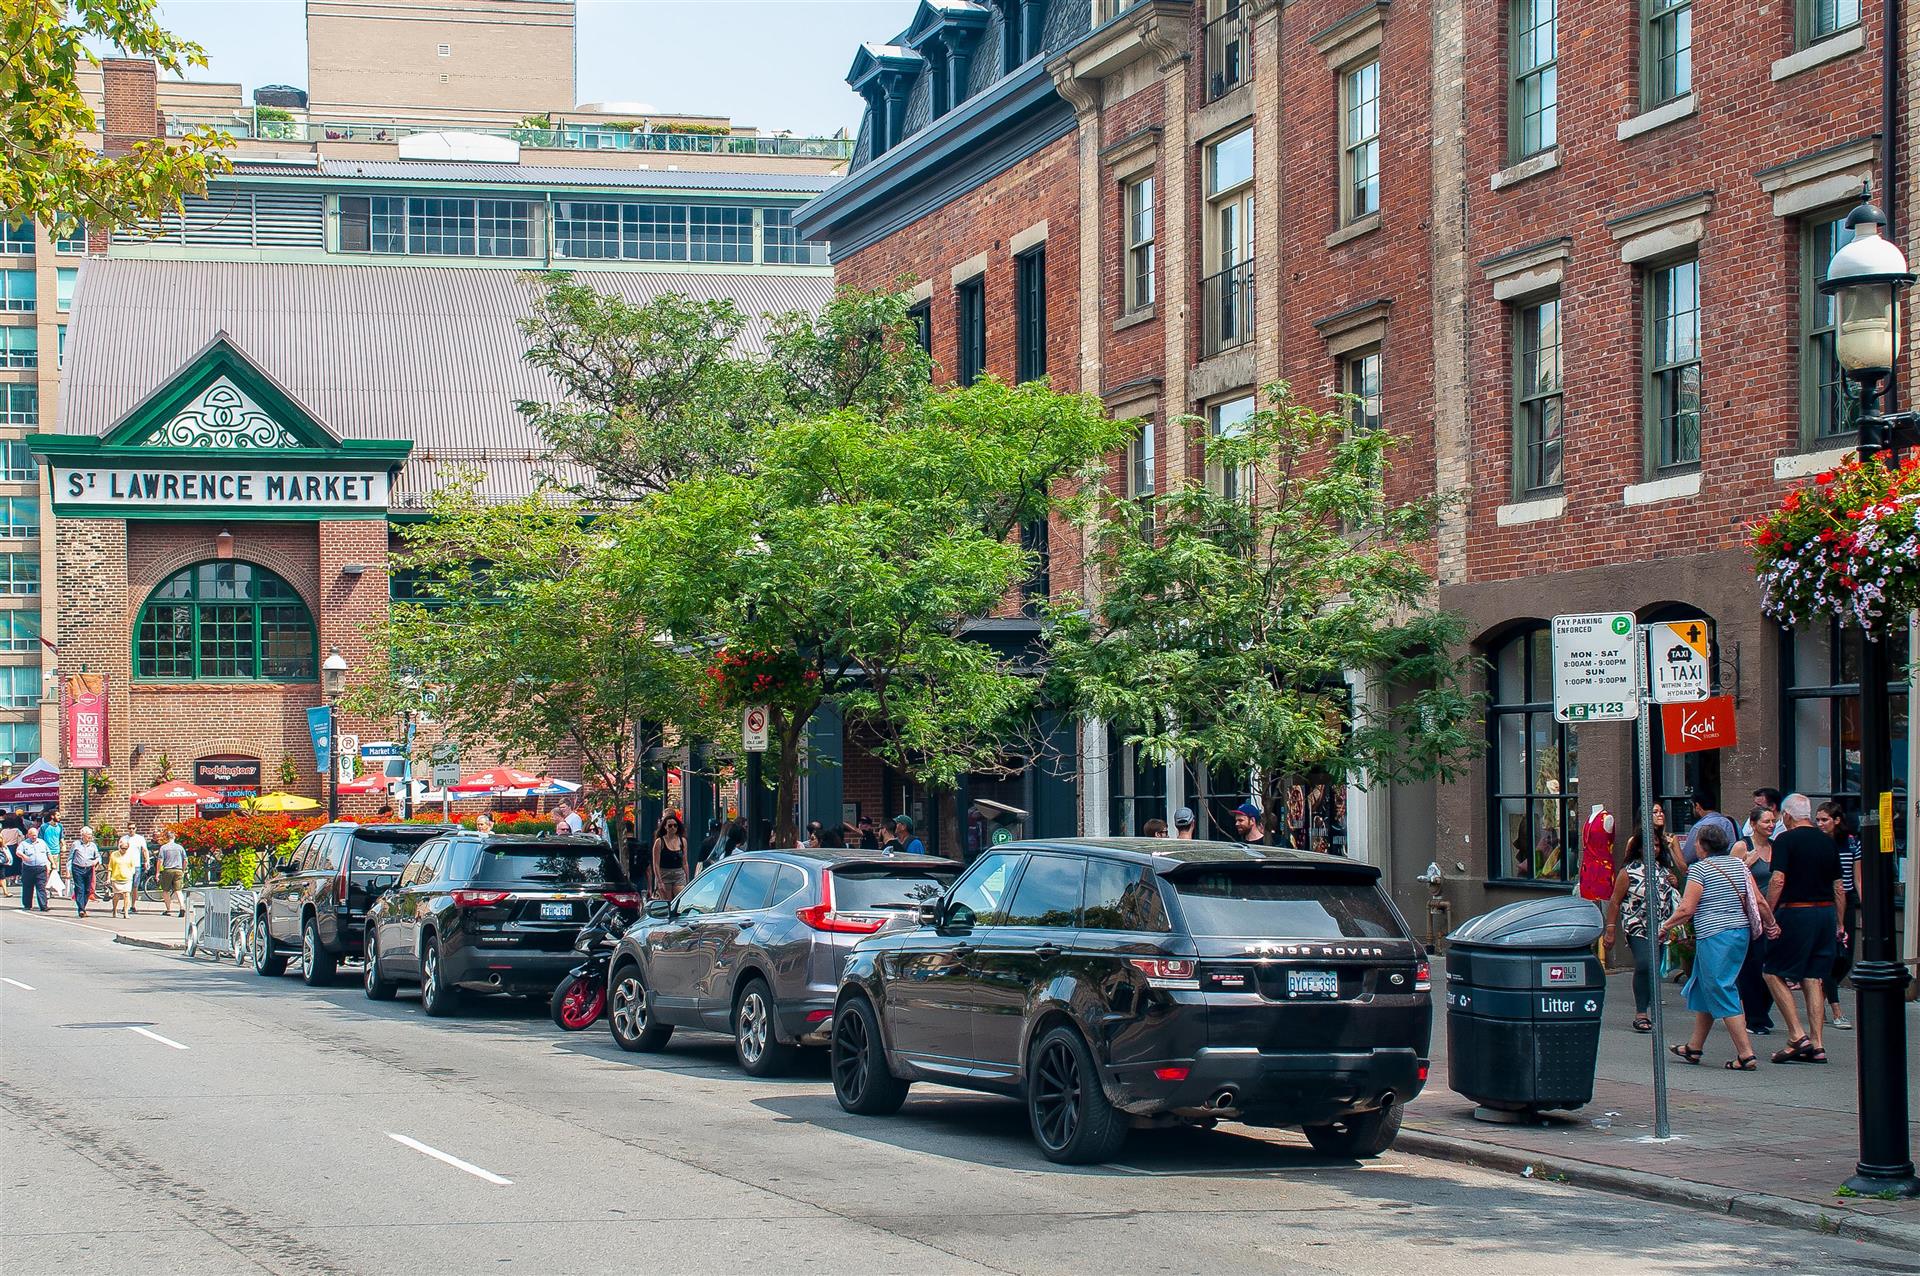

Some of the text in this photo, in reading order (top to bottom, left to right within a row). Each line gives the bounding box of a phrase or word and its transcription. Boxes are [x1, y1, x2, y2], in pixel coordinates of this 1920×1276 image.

[110, 473, 253, 500] LAWRENCE
[267, 475, 374, 501] MARKET
[1572, 617, 1603, 625] PARKING
[1557, 626, 1592, 634] ENFORCED
[1570, 651, 1592, 659] MON
[1671, 650, 1689, 658] TAXI
[1563, 660, 1592, 668] 8:00AM
[1659, 665, 1702, 682] 1 TAXI
[1588, 702, 1624, 713] 4123
[1681, 708, 1715, 743] Kochi
[1244, 945, 1383, 956] RANGE ROVER
[1563, 966, 1577, 974] OLD
[1541, 997, 1575, 1013] Litter
